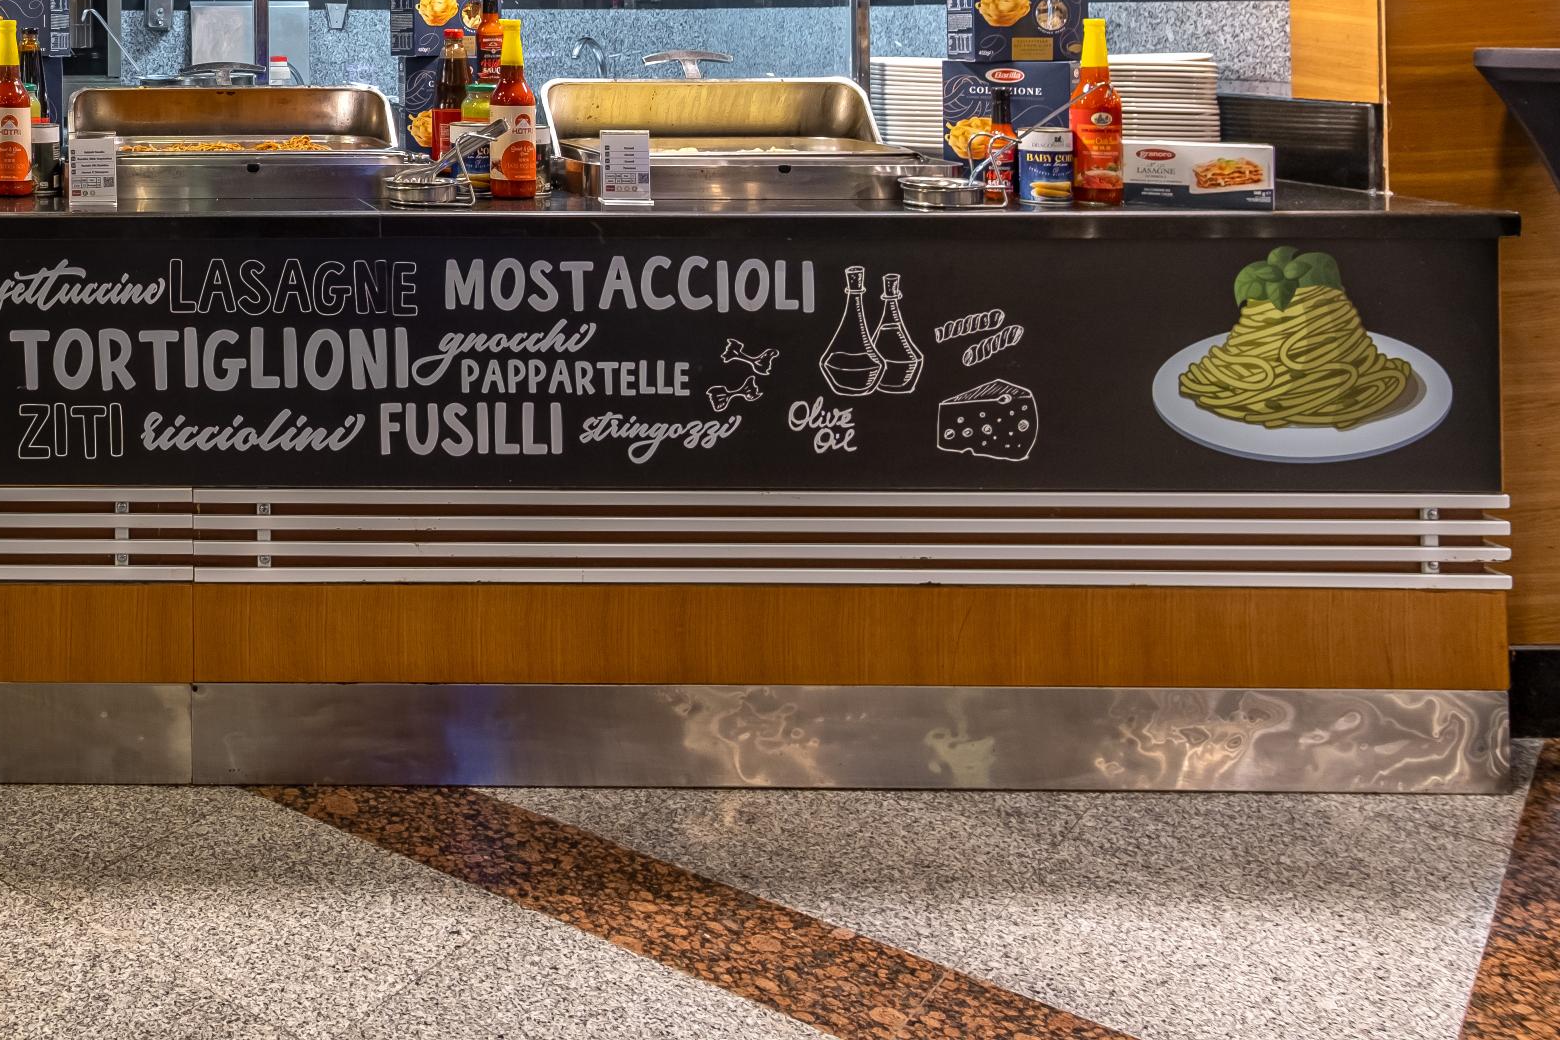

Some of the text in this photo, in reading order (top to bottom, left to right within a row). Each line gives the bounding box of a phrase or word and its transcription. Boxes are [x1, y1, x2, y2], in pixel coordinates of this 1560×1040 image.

[994, 71, 1021, 79] Barilla
[1026, 153, 1053, 162] BABY
[1139, 150, 1173, 160] granoro
[1137, 166, 1176, 175] LASAGNE
[169, 258, 418, 317] LASAGNE
[444, 255, 815, 313] MOSTACCIOLI
[9, 326, 409, 391] TORTIGLIONI
[411, 318, 597, 386] gnocchi
[460, 359, 690, 396] PAPPARTELLE
[788, 396, 855, 431] Olive
[18, 402, 124, 460] ZITI
[380, 402, 563, 457] FUSILLI
[578, 411, 742, 464] stringozzi
[813, 428, 857, 454] Oil
